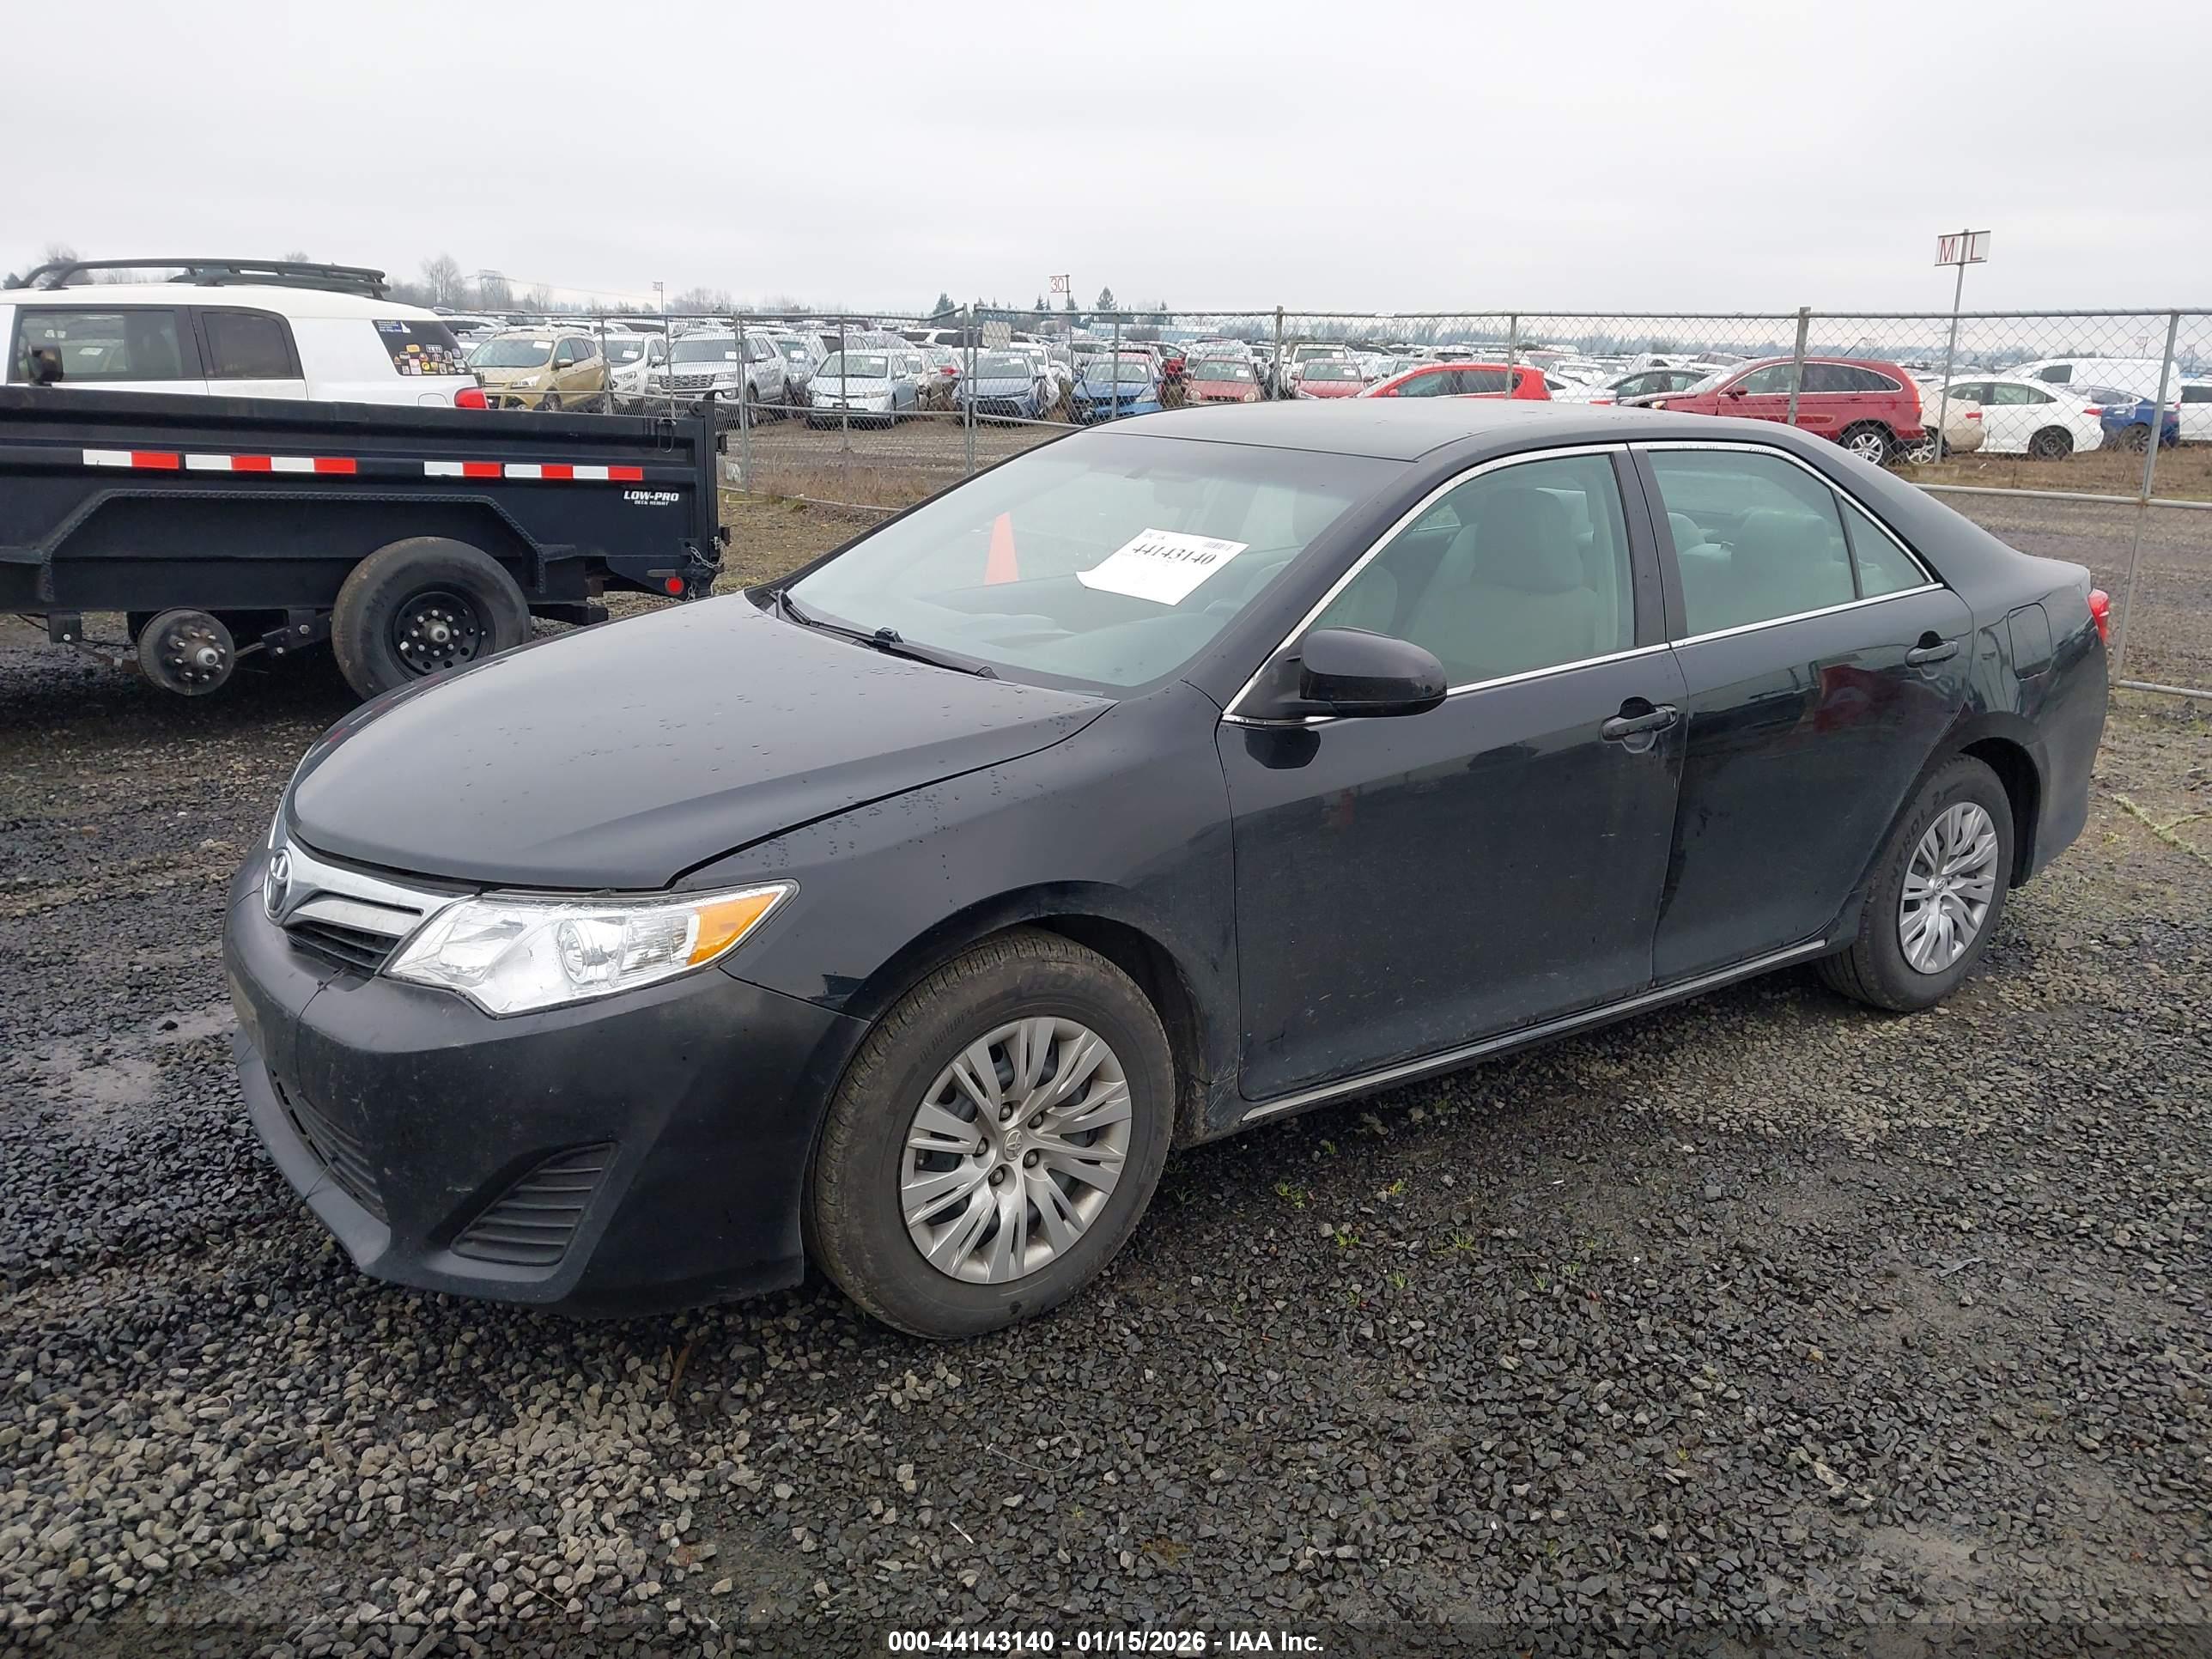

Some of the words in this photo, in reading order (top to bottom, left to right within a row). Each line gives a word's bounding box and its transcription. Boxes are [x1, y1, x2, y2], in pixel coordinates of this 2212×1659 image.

[1939, 237, 1955, 263] M
[1970, 234, 1983, 261] L
[1050, 277, 1065, 291] 30
[623, 490, 680, 501] LOW-PRO
[1133, 543, 1217, 565] 44143140
